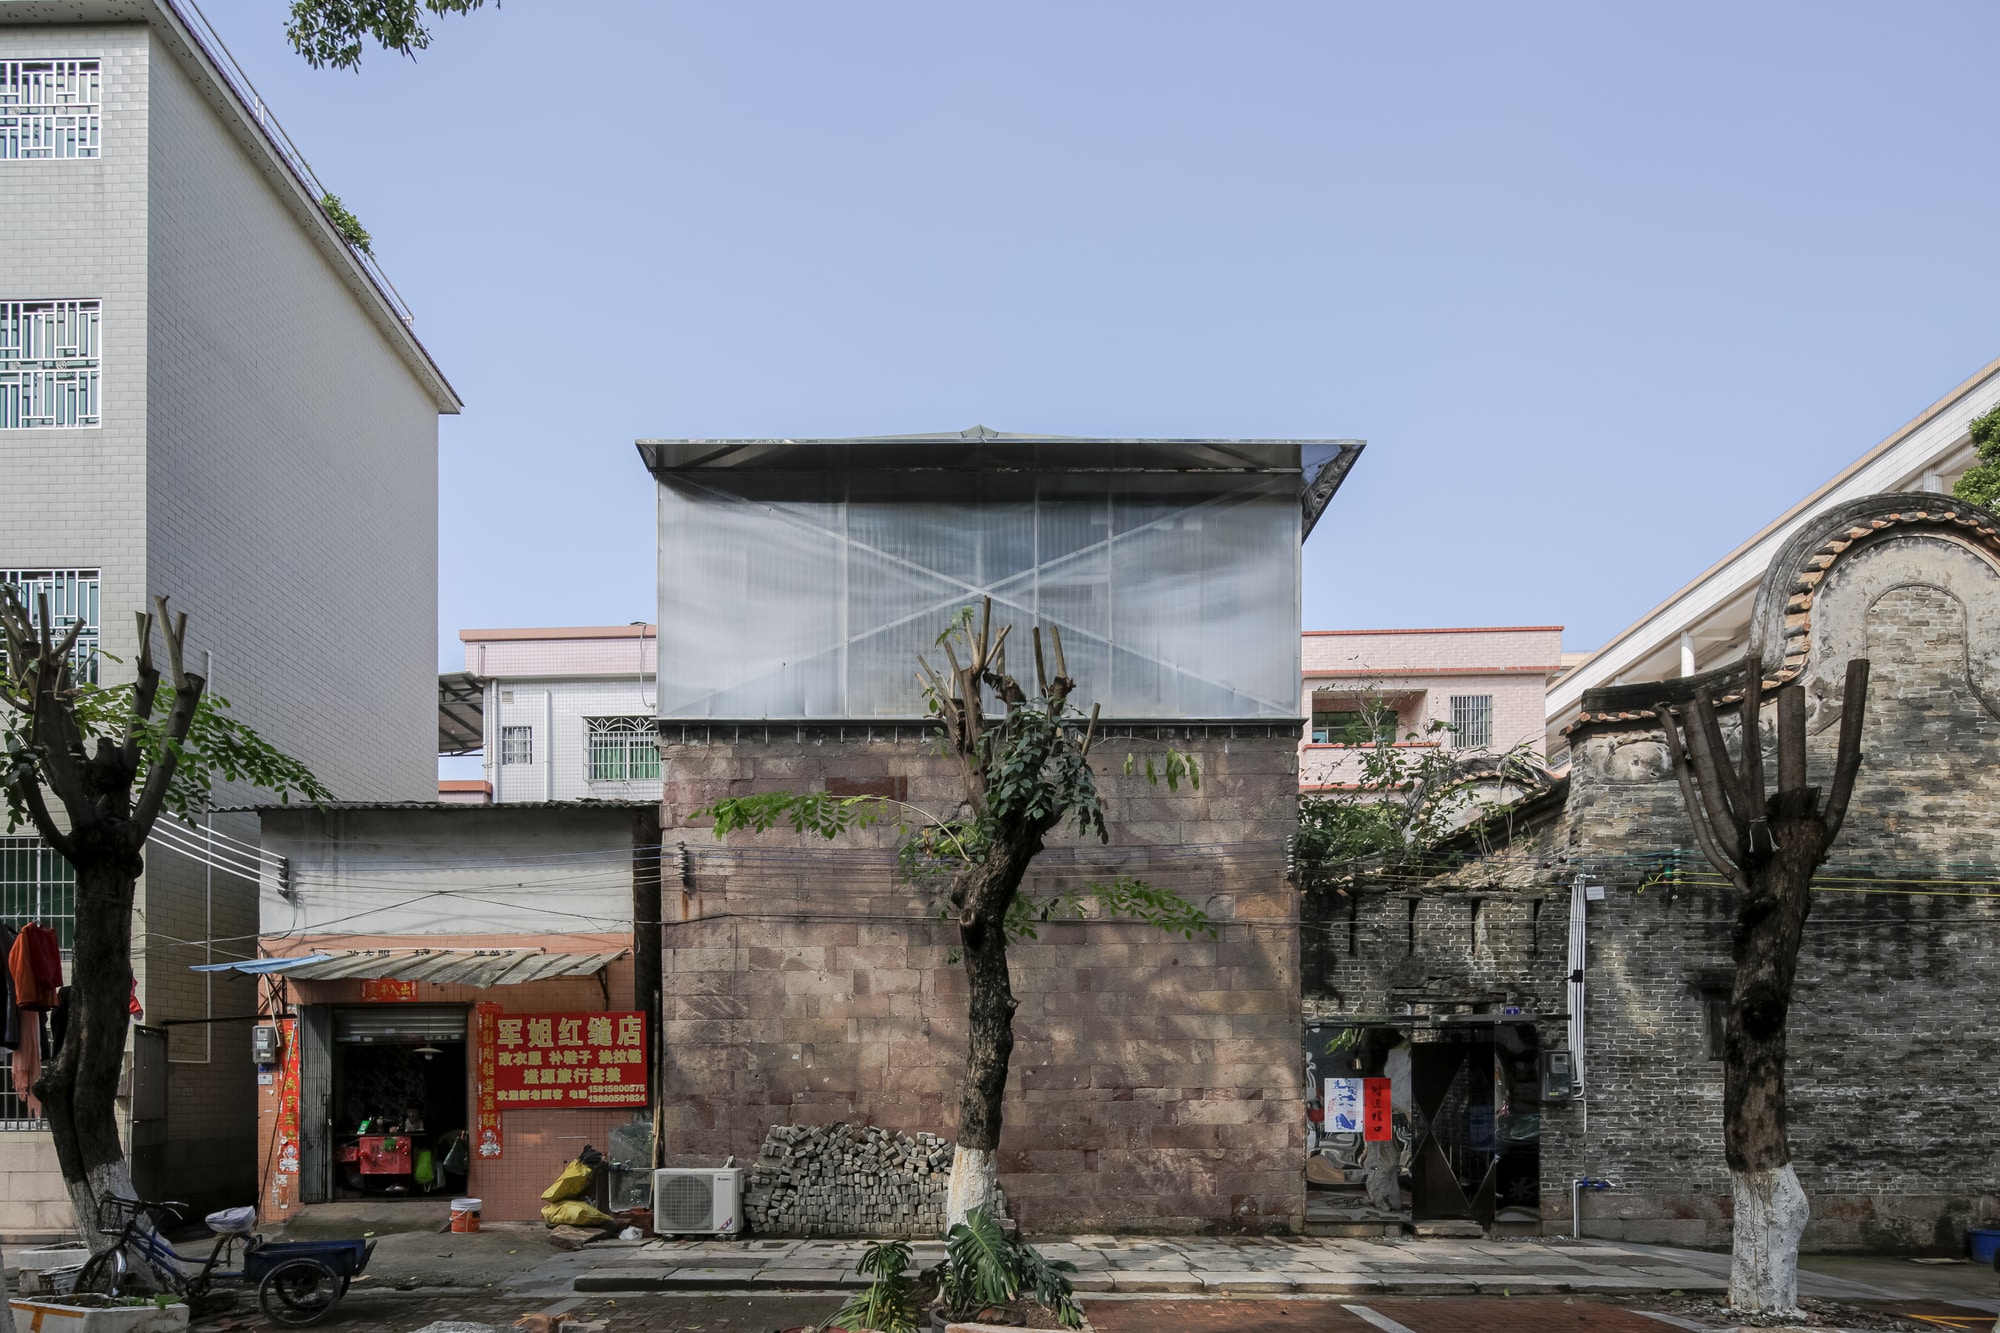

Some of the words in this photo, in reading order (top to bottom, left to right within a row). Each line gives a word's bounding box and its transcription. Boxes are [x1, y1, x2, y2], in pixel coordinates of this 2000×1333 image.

[497, 1015, 642, 1049] 军姐红缝店
[498, 1051, 542, 1066] 改衣服
[549, 1050, 593, 1065] 补鞋子
[598, 1049, 642, 1064] 换拉链
[497, 1088, 563, 1101] 欢迎新老顾客
[568, 1089, 588, 1099] 电话
